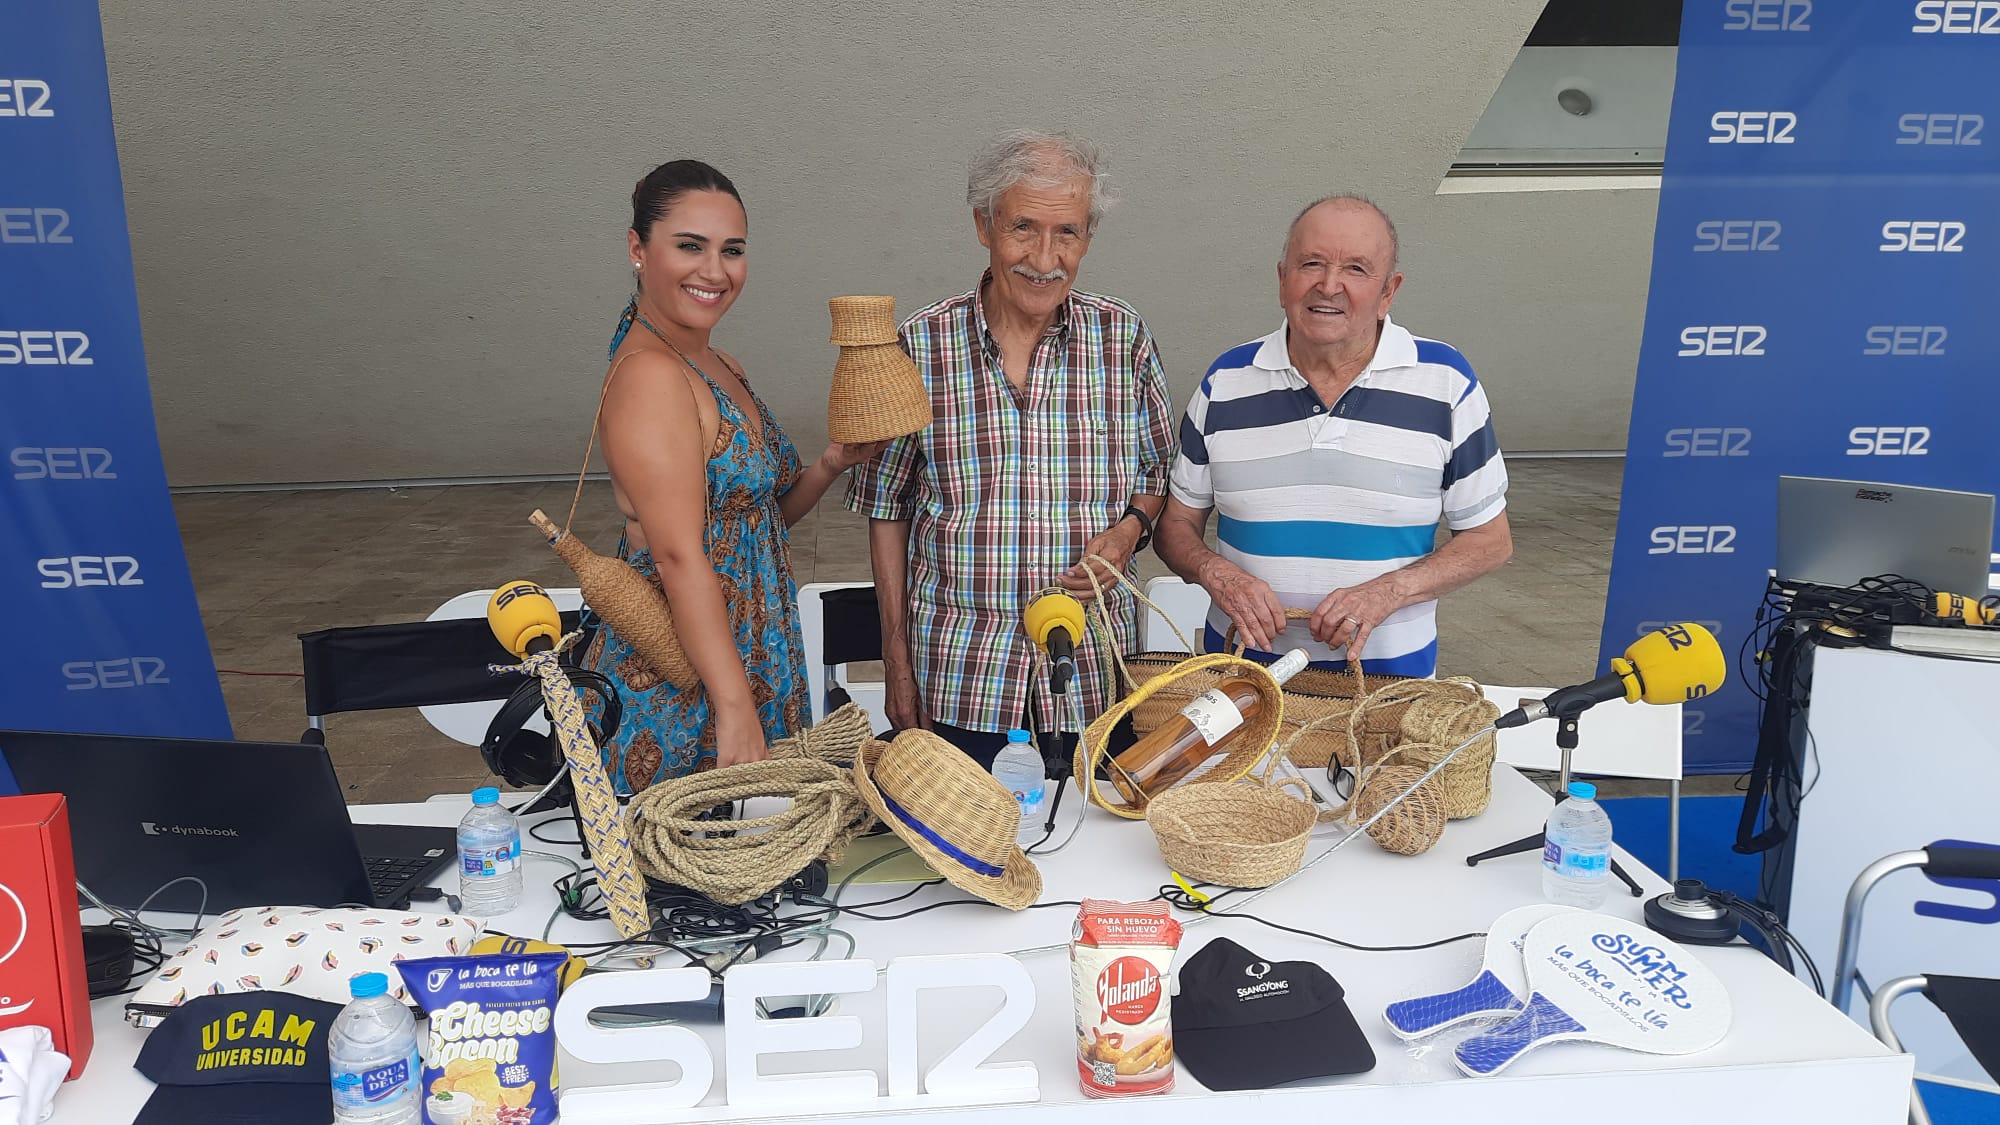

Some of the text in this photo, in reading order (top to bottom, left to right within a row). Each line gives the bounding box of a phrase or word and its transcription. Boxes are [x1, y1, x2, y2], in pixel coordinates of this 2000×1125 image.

[1723, 0, 1813, 31] SER
[1912, 1, 2000, 34] SER
[1709, 111, 1797, 144] SER
[1895, 113, 1984, 145] SER
[1693, 220, 1782, 252] SER
[1879, 220, 1966, 252] SER
[1678, 325, 1767, 357] SER
[1863, 325, 1948, 356] SER
[1662, 427, 1752, 458] SER
[1846, 426, 1931, 456] SER
[10, 447, 117, 480] SER
[1647, 525, 1737, 555] SER
[37, 556, 144, 588] SER
[62, 656, 170, 690] SER
[171, 825, 240, 837] dynabook
[1097, 917, 1121, 925] PARA
[1106, 925, 1158, 933] SIN HUEVO
[458, 968, 470, 980] la
[474, 965, 500, 978] boca
[505, 963, 519, 976] te
[491, 979, 533, 988] BOCADILLOS
[1554, 944, 1574, 959] la
[1575, 959, 1616, 990] boca
[1619, 990, 1642, 1008] te
[1568, 971, 1590, 988] QUE
[1099, 961, 1158, 1015] Yolanda
[202, 1009, 316, 1051] UCAM
[430, 1001, 550, 1041] Cheese
[554, 952, 1041, 1117] SER
[195, 1047, 306, 1071] UNIVERSIDAD
[427, 1031, 519, 1069] Bacon
[366, 1063, 405, 1082] AQUA
[368, 1073, 405, 1091] DEUS
[504, 1065, 526, 1075] BEST
[505, 1073, 527, 1084] FRIES
